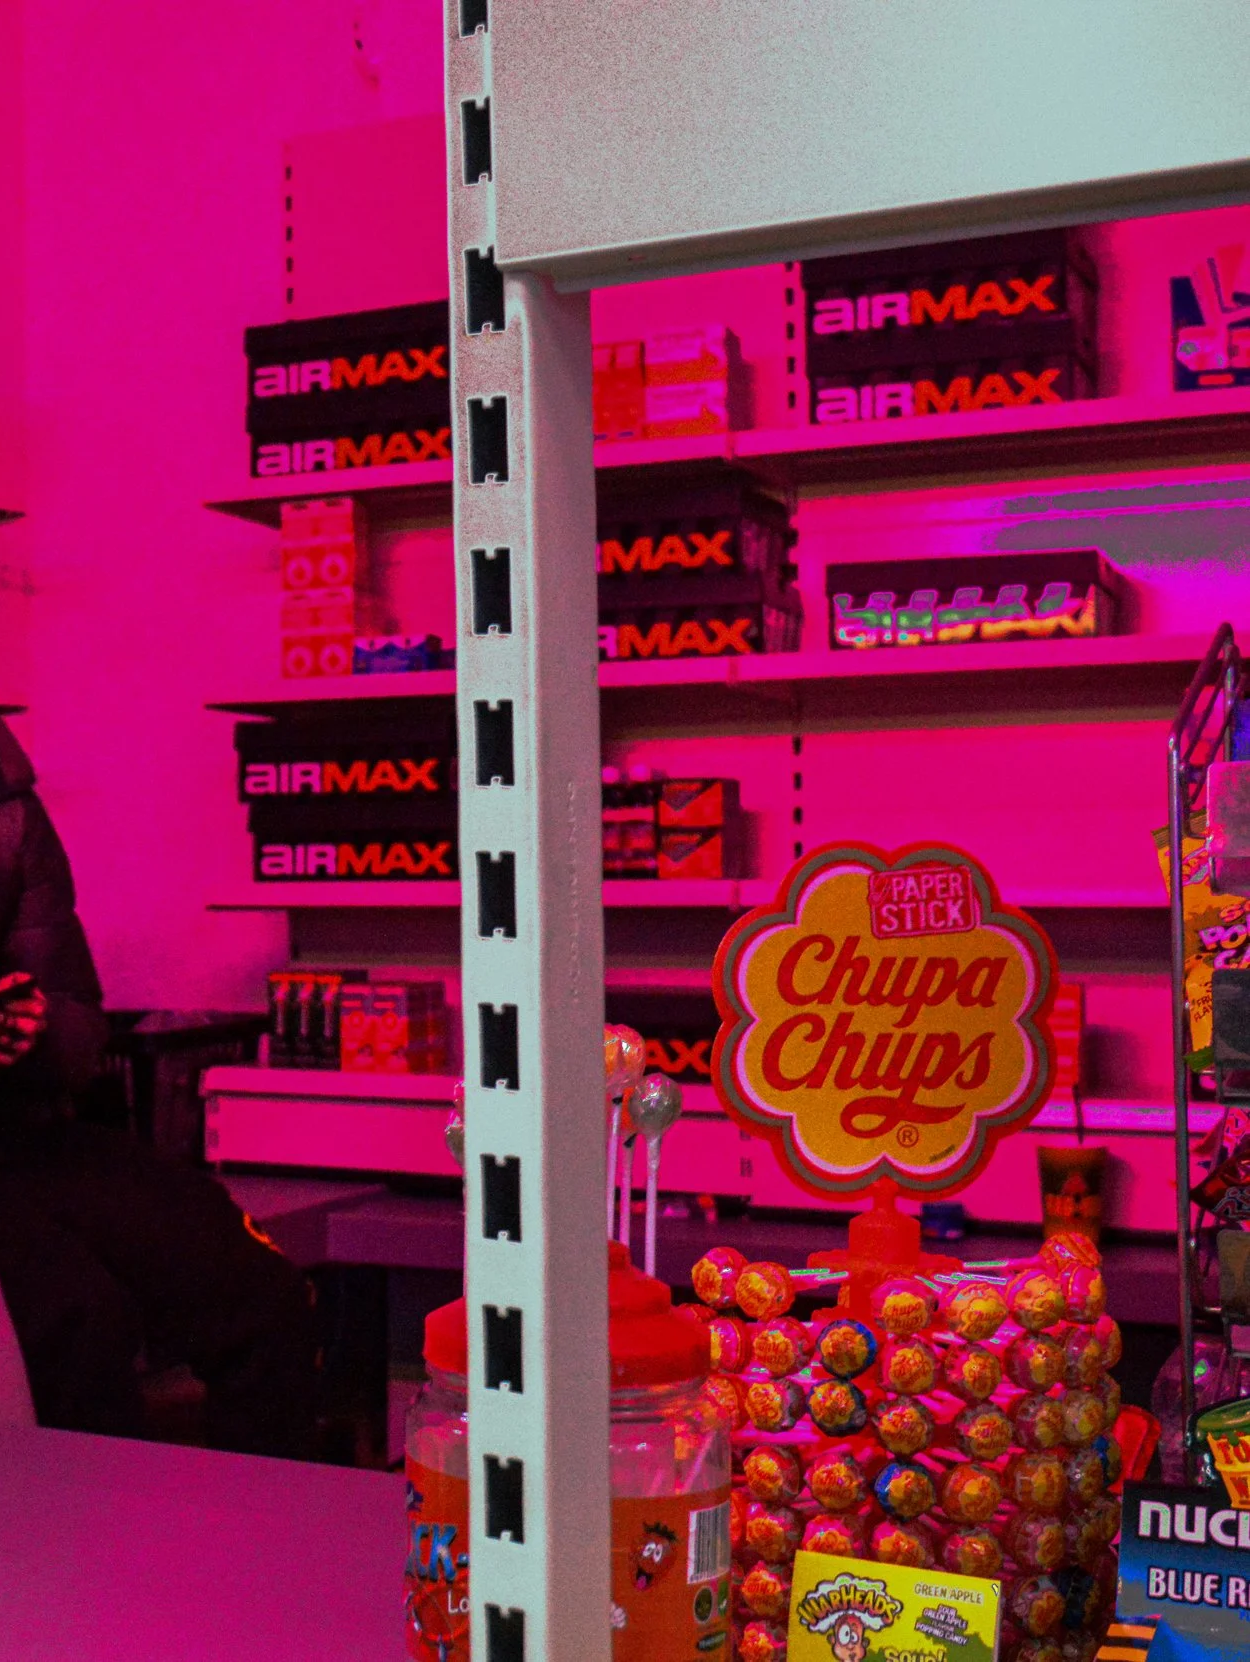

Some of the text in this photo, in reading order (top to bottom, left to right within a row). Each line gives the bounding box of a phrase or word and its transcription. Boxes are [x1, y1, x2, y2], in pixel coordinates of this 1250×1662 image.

[597, 531, 733, 573] MAX
[598, 618, 753, 660] RMAX
[892, 872, 965, 902] PAPER
[881, 901, 966, 933] STICK
[1198, 915, 1250, 951] PO
[776, 934, 1009, 1028] Chupa
[762, 1012, 996, 1139] Chups
[447, 1591, 469, 1614] Lo
[914, 1582, 984, 1605] GREEN APPLE
[1148, 1566, 1250, 1609] BLUE R
[915, 1622, 969, 1646] POPPING CANDY
